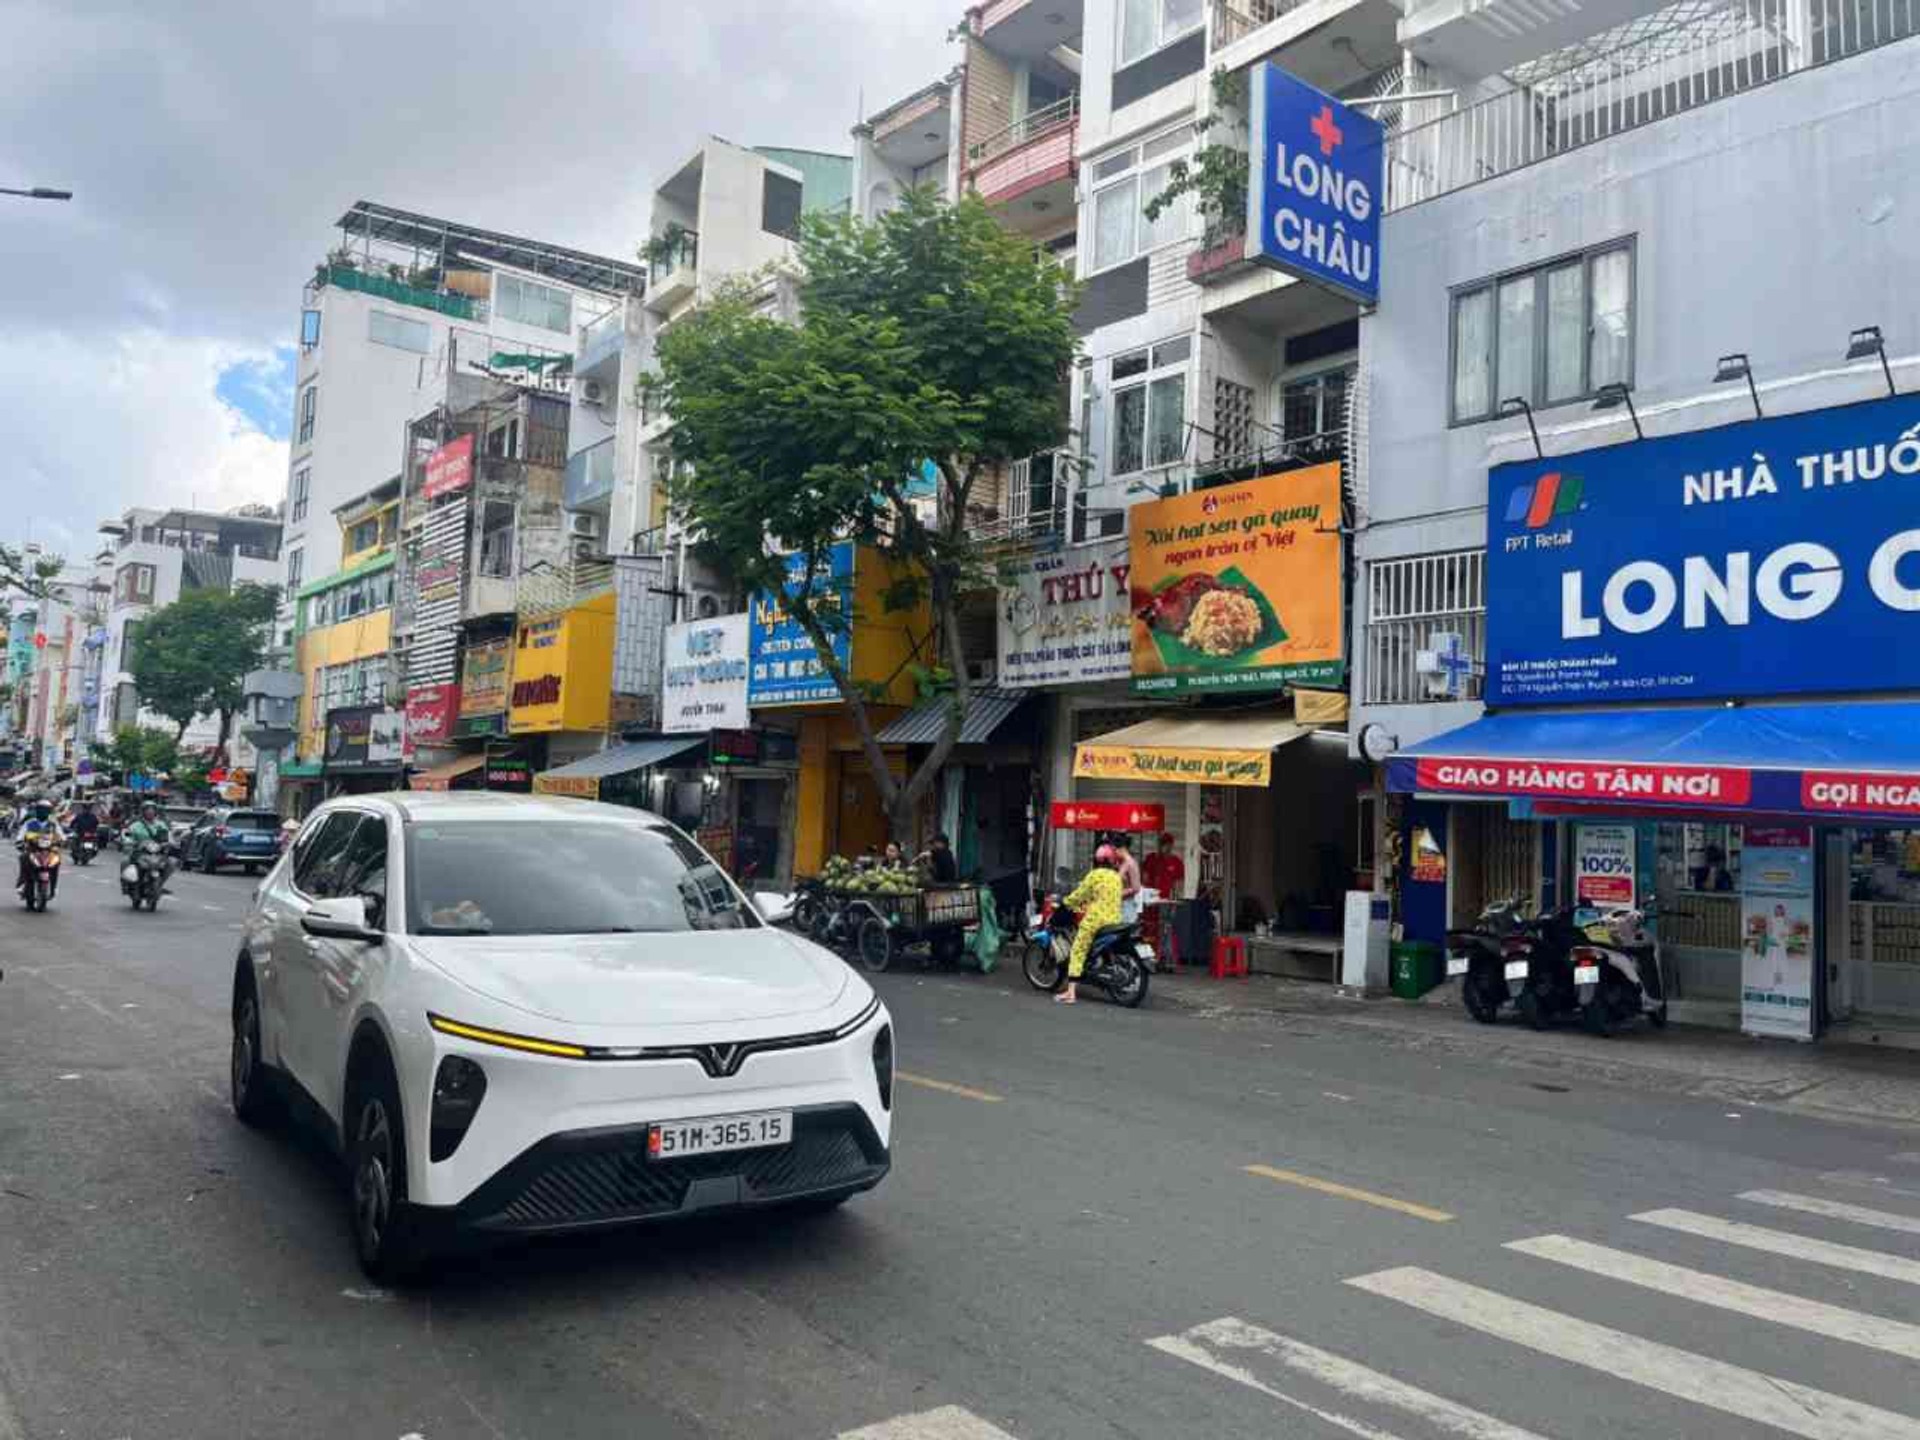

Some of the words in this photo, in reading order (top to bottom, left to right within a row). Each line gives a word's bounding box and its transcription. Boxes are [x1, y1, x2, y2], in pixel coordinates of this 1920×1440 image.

[1276, 141, 1371, 221] LONG
[1273, 208, 1372, 282] CHÂU
[1683, 452, 1778, 505] NHÀ
[1177, 523, 1206, 543] hạt
[1207, 518, 1238, 535] sen
[1241, 509, 1267, 531] gà
[1270, 504, 1321, 527] quay
[1505, 535, 1530, 553] FPT
[1535, 529, 1573, 549] Retail
[1164, 549, 1203, 567] ngon
[1260, 530, 1297, 549] Việt
[1042, 560, 1104, 604] THÚ
[1561, 541, 1844, 640] LONG
[1437, 766, 1500, 787] GIAO
[1506, 764, 1585, 791] HÀNG
[1593, 770, 1656, 799] TẬN
[1662, 771, 1721, 797] NƠI
[1810, 783, 1858, 808] GỌI
[1582, 856, 1633, 873] 100%
